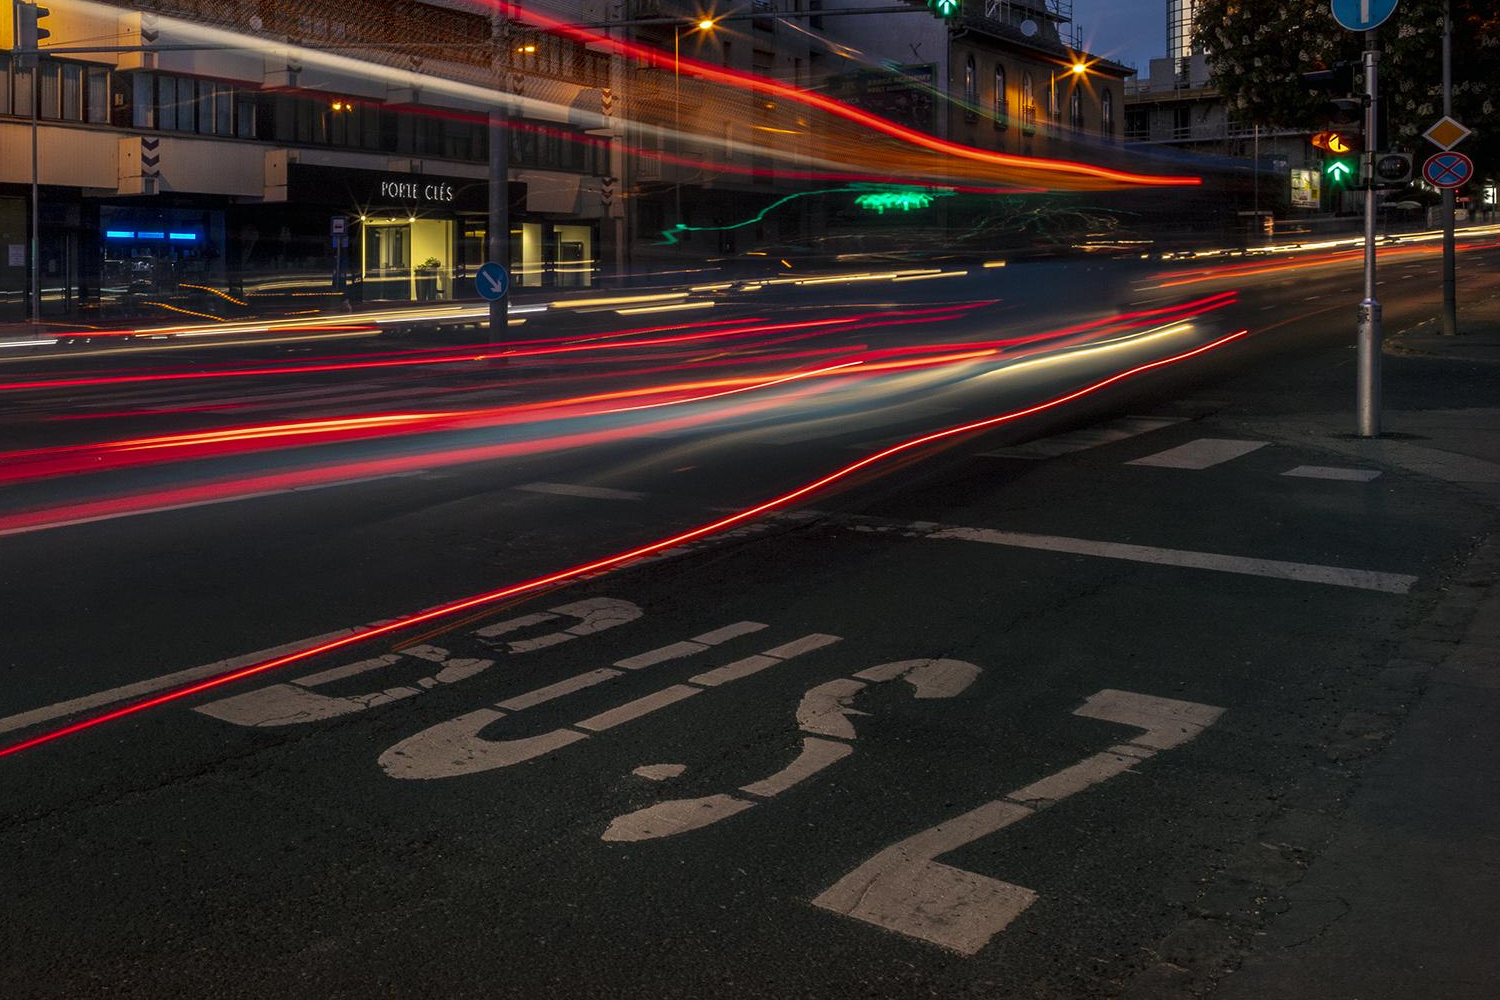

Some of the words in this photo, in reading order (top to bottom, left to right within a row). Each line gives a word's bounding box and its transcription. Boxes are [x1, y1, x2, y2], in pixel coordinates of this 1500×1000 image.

[381, 181, 417, 199] PORTE
[425, 182, 453, 202] CLÉS
[194, 597, 1228, 958] BUSZ
